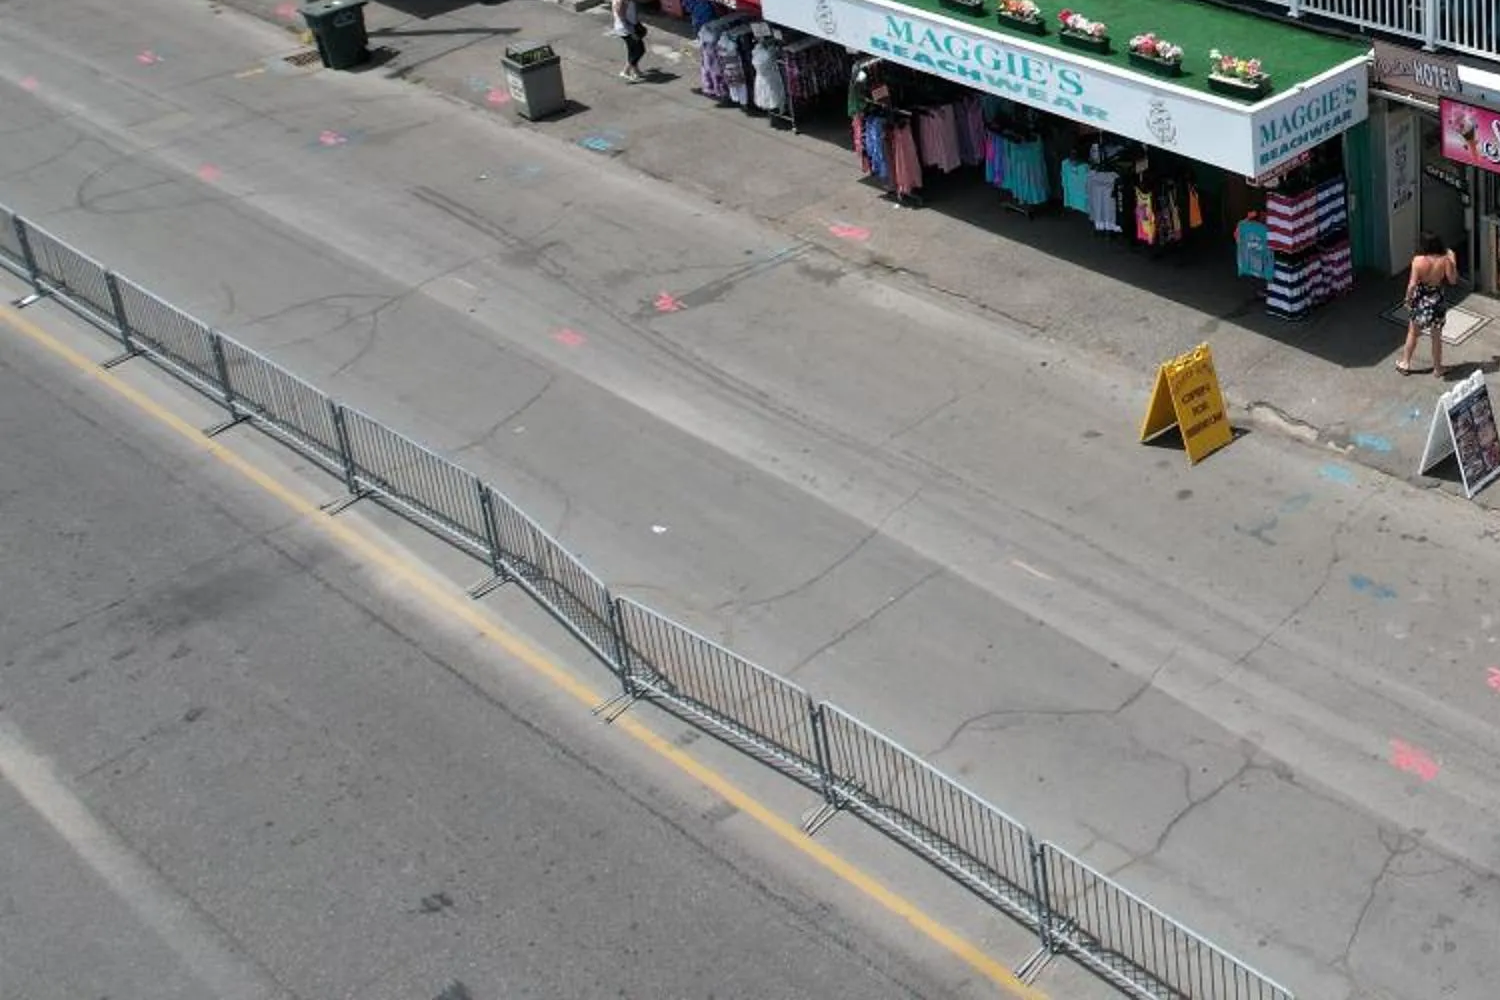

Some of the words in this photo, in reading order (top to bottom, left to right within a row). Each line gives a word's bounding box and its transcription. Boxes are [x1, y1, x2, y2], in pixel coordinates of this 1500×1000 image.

[870, 36, 1109, 121] BEACHWEAR
[885, 15, 1084, 97] MAGGIE'S
[1414, 60, 1463, 95] HOTEL
[1259, 78, 1357, 148] MAGGIE'S
[1259, 108, 1352, 165] BEACHWEAR
